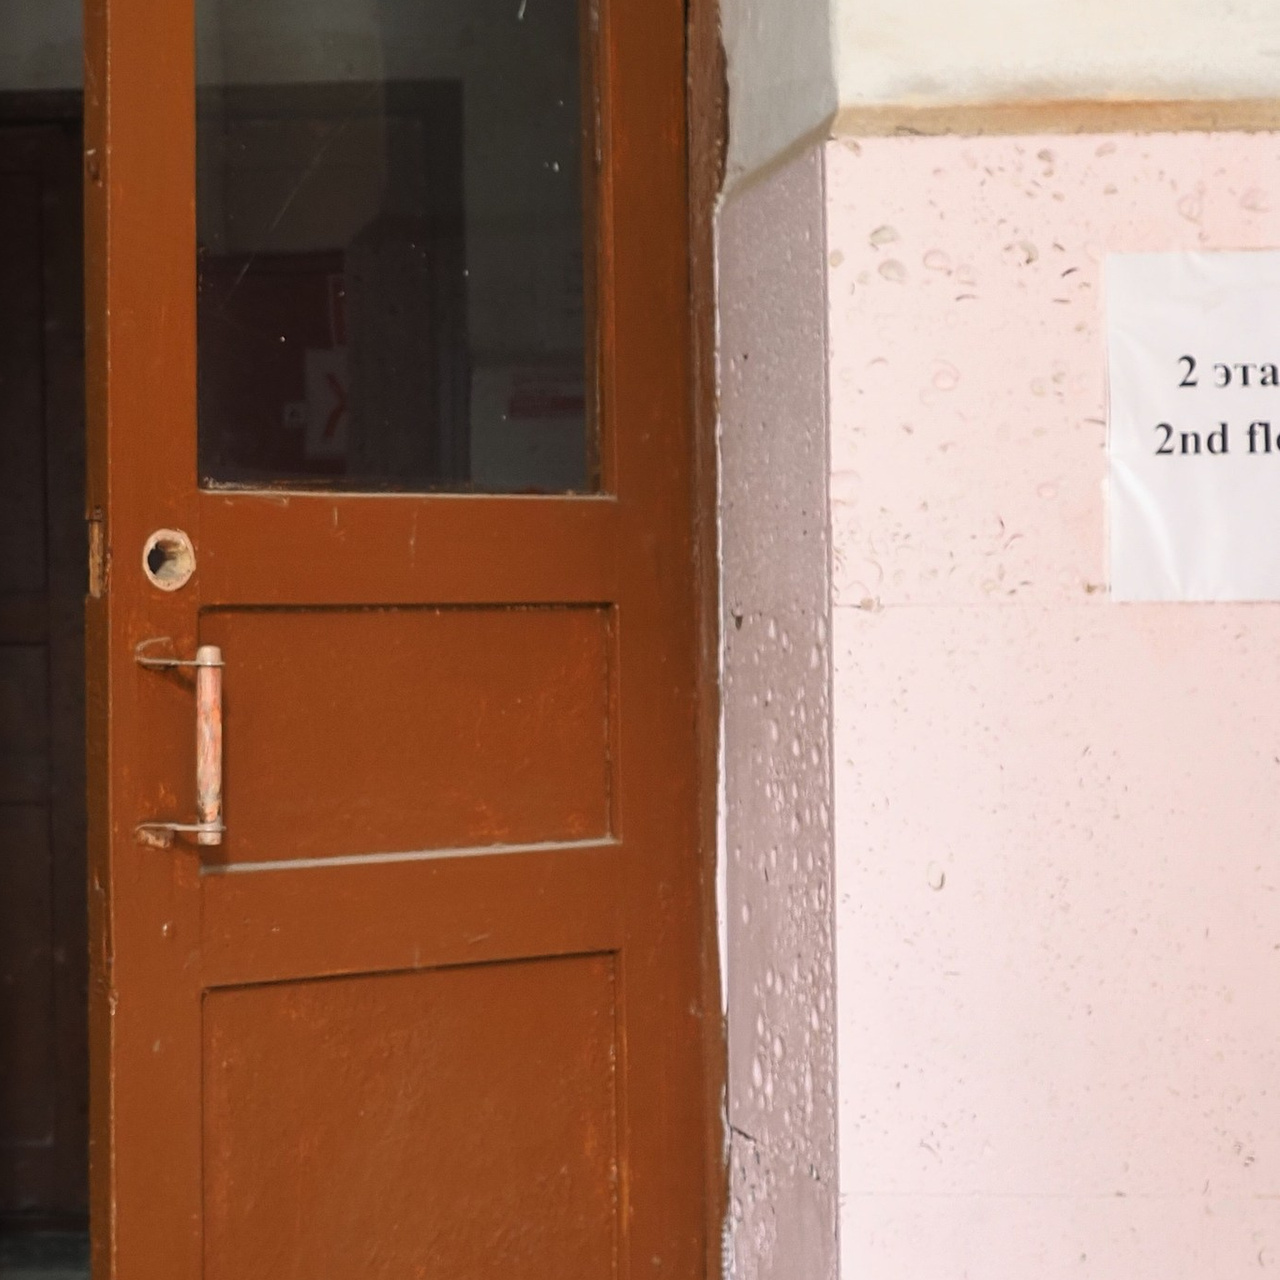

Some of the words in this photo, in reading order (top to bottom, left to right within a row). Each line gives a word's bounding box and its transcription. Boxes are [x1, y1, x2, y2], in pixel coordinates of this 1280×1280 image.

[1177, 354, 1198, 388] 2
[1154, 422, 1229, 455] 2nd
[1246, 421, 1280, 455] fl
